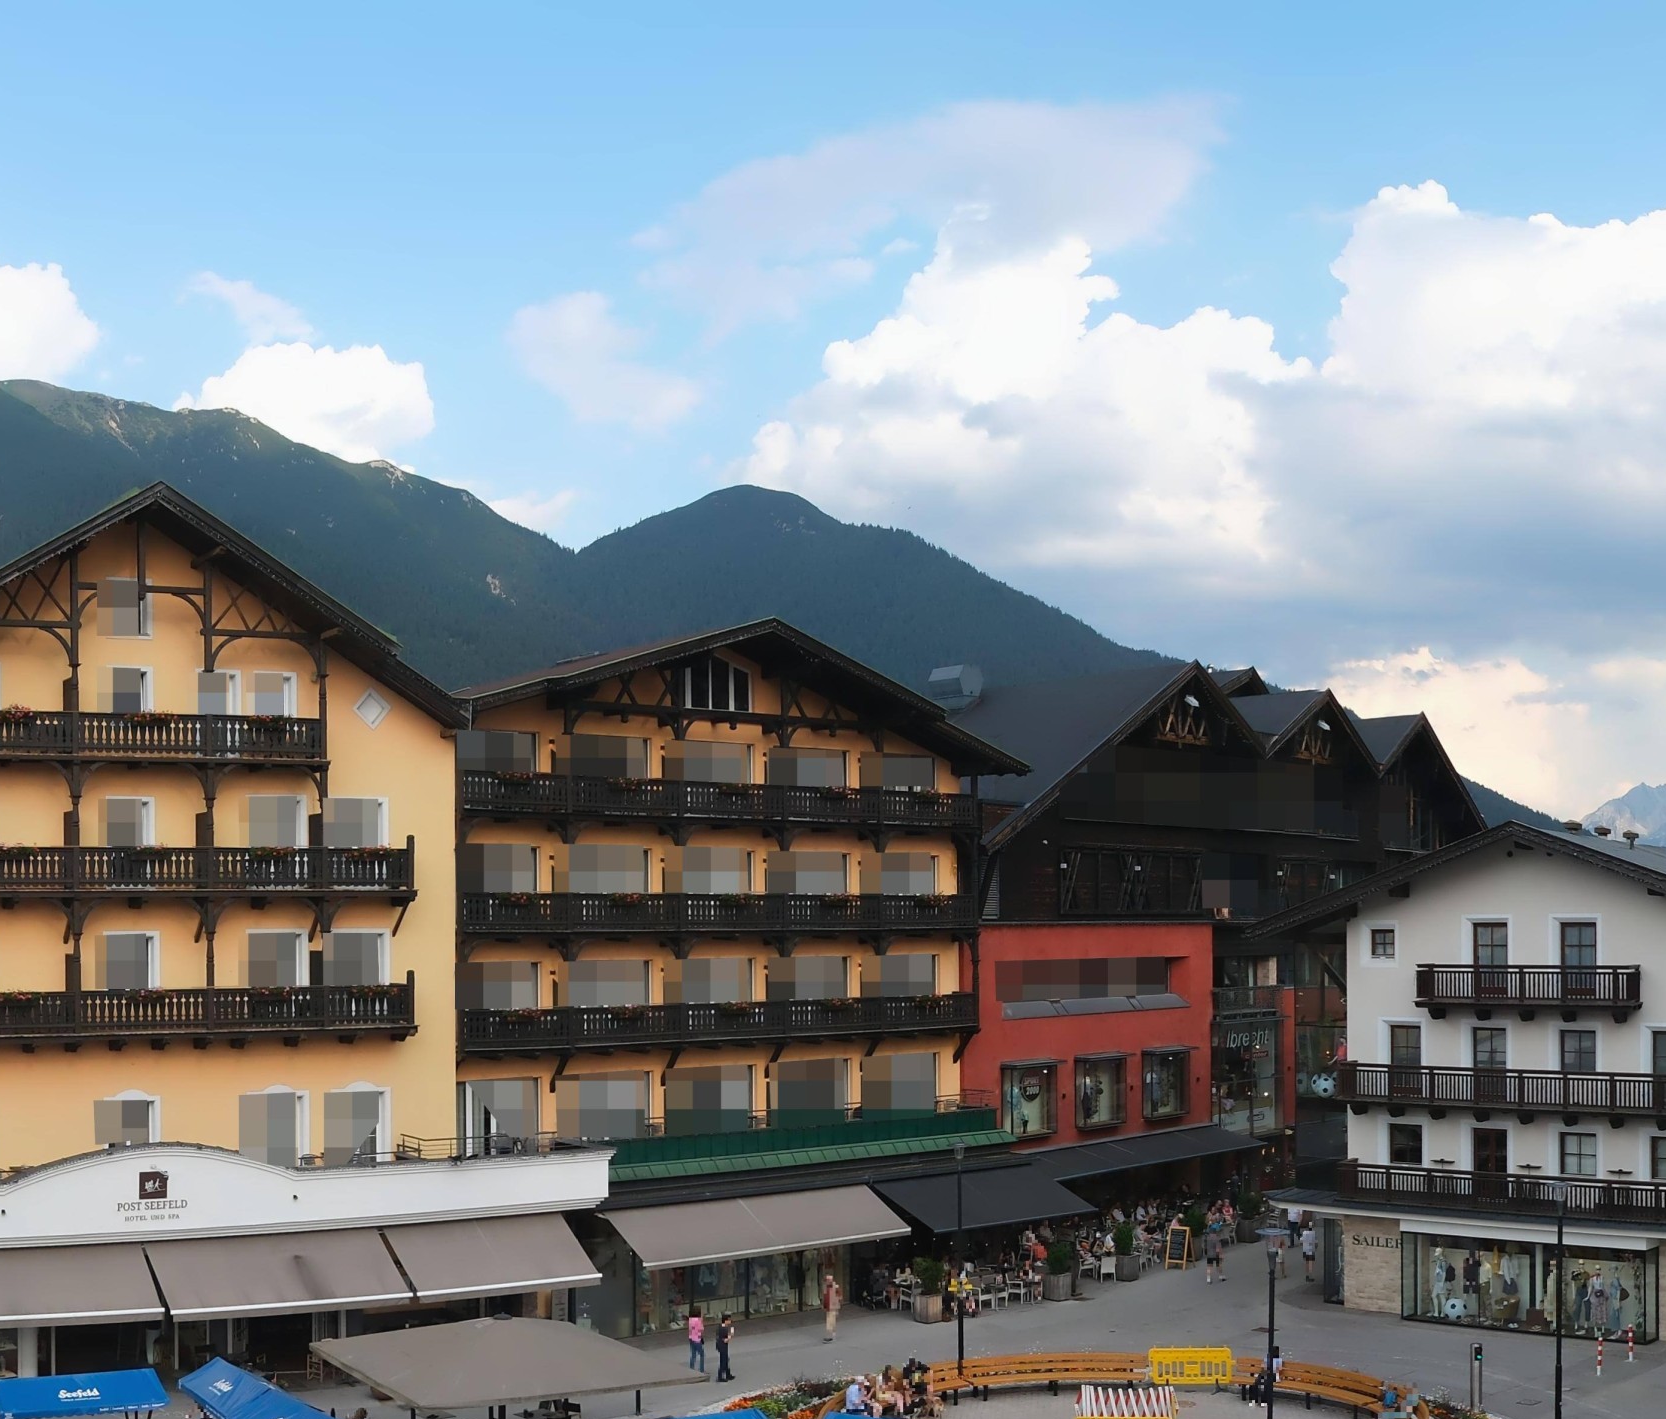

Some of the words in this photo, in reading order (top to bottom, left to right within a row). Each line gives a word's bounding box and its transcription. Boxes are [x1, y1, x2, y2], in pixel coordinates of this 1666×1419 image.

[117, 1202, 142, 1212] POST
[144, 1199, 188, 1211] SEEFELD
[58, 1387, 100, 1400] Seefeld
